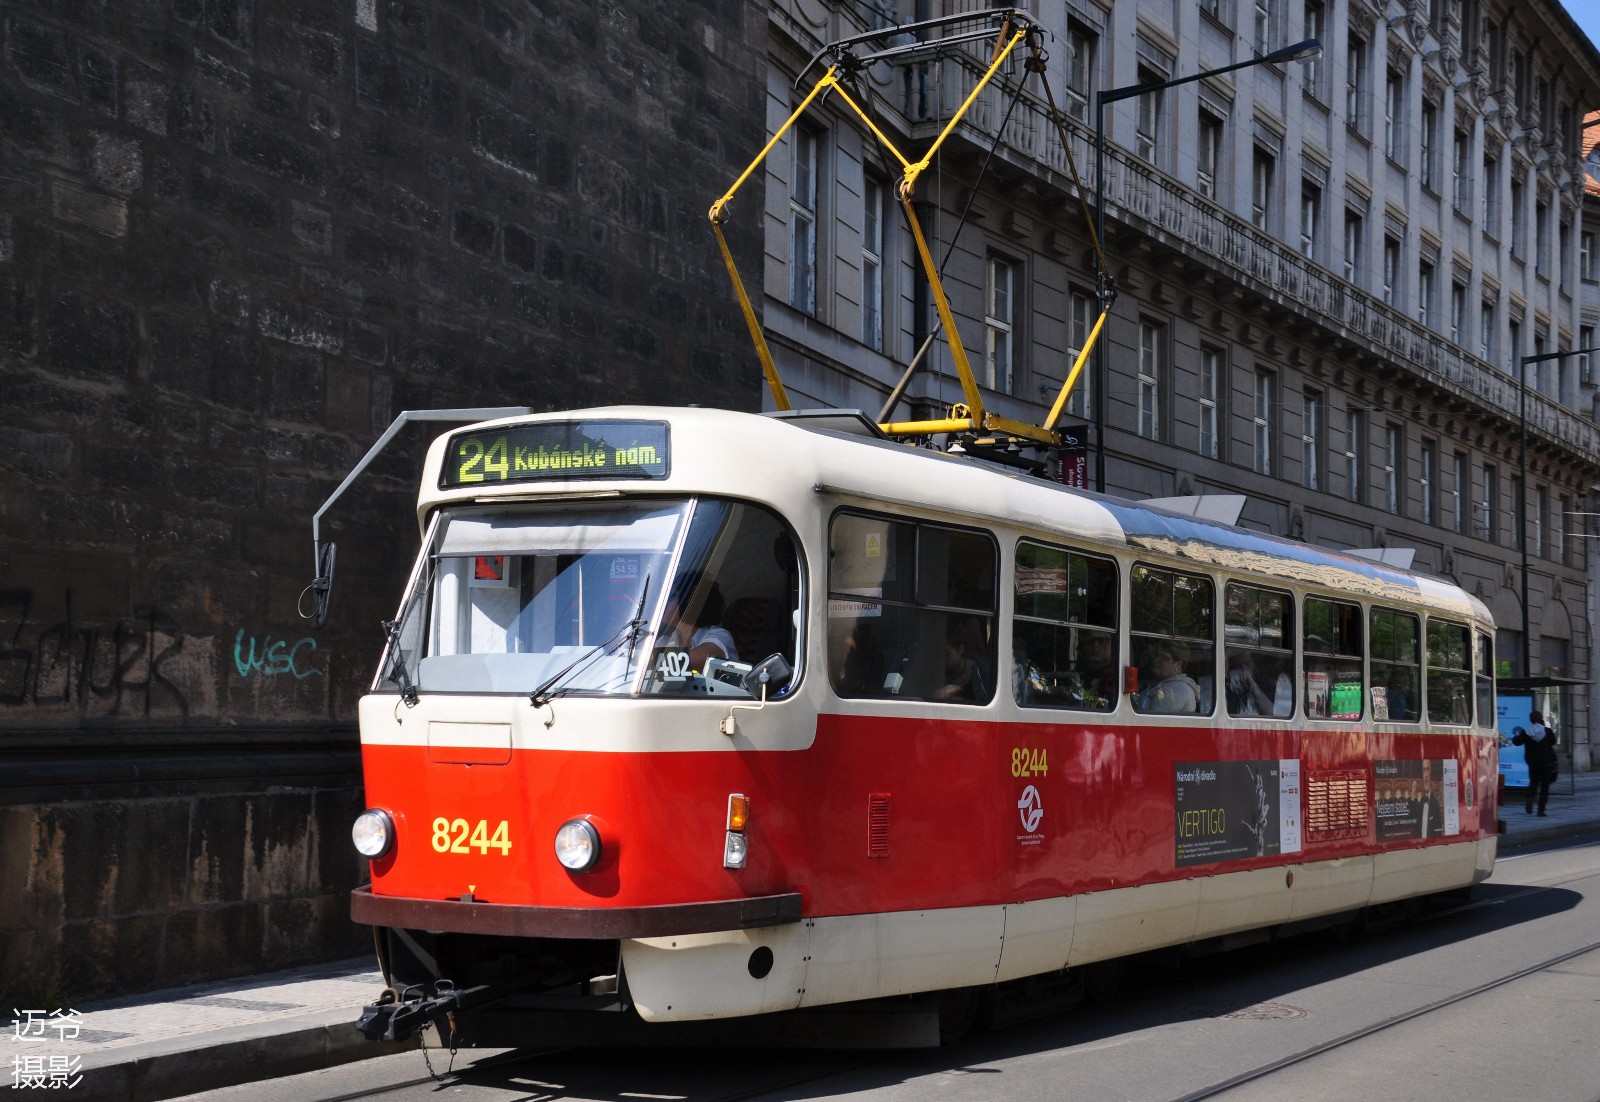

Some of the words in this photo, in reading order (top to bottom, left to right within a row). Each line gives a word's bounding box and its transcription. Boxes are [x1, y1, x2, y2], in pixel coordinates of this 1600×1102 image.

[459, 435, 509, 483] 24
[515, 441, 606, 471] Kubánské
[615, 439, 662, 466] nám.
[656, 651, 692, 677] 402
[1011, 747, 1049, 778] 8244
[431, 816, 513, 857] 8244
[1177, 808, 1226, 838] VERTIGO
